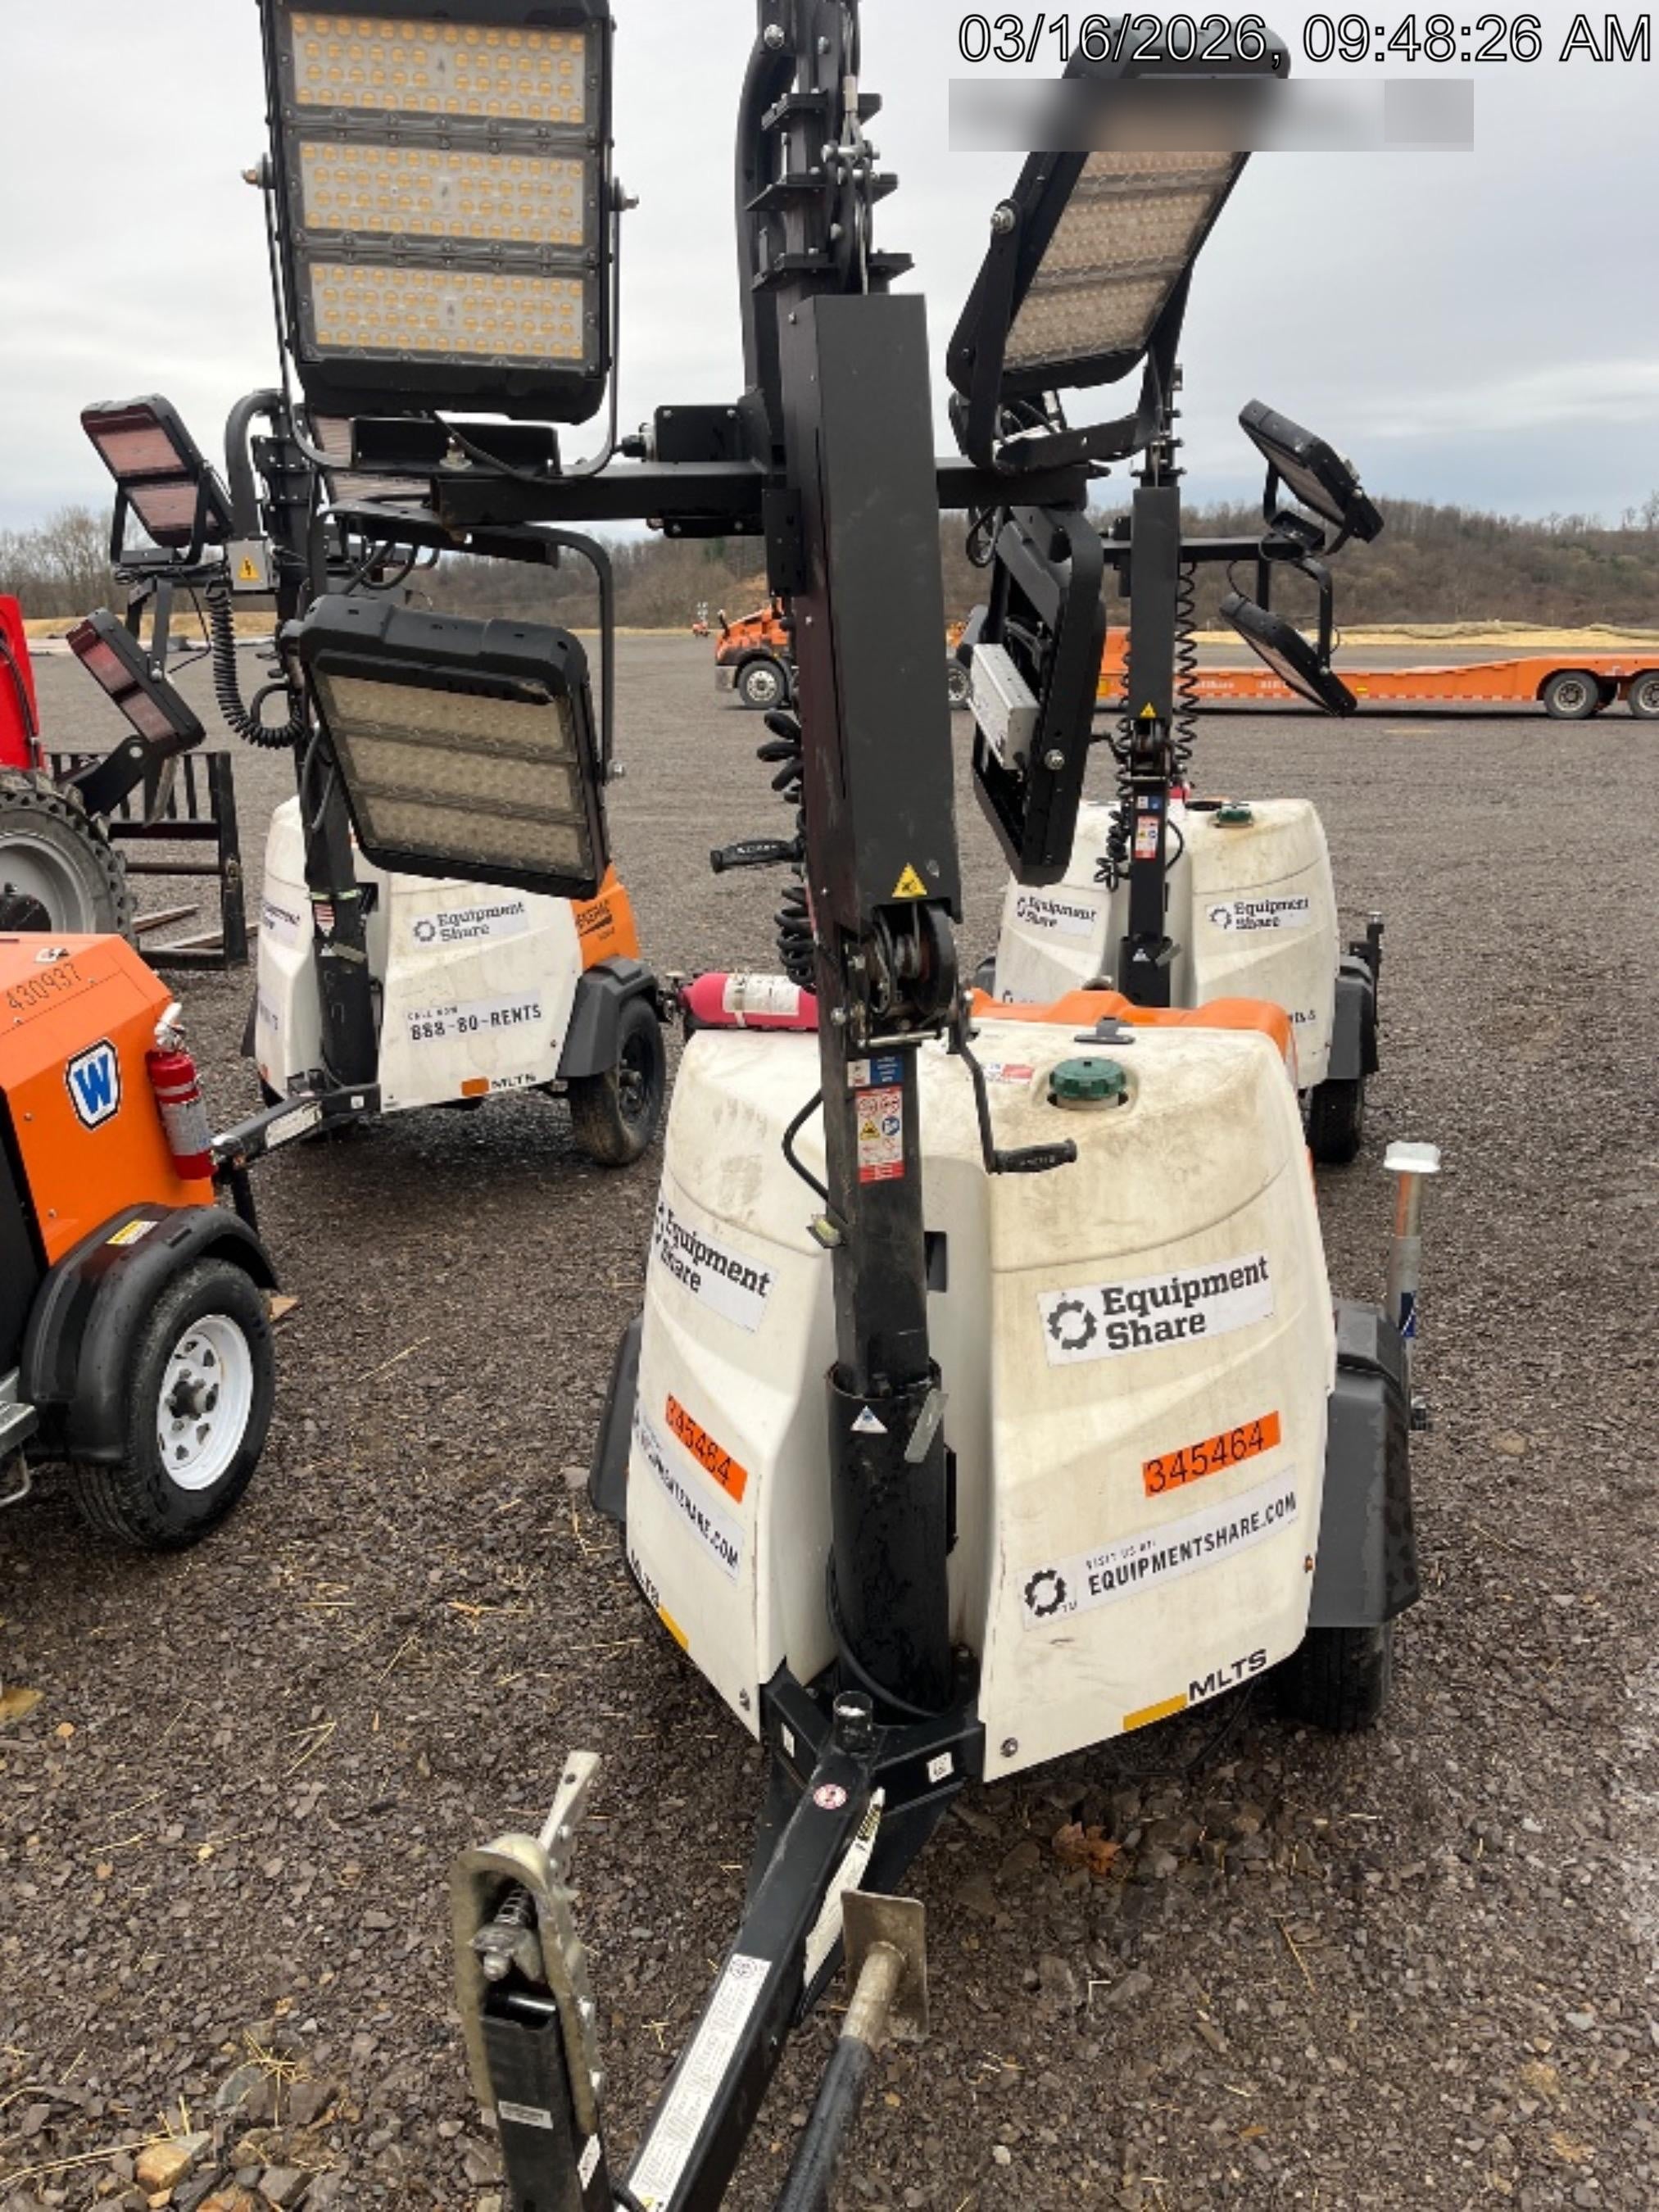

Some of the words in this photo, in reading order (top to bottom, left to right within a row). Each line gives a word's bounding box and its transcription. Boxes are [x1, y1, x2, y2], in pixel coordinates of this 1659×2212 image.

[5, 962, 82, 1012] 430937
[411, 1004, 542, 1040] 888-80-RENTS
[1100, 1254, 1270, 1318] Equipment
[1105, 1312, 1206, 1351] Share
[1147, 1420, 1265, 1494] 345464
[1087, 1491, 1297, 1597] EQUIPMENTSHARE.COM
[1188, 1648, 1268, 1702] MLTS
